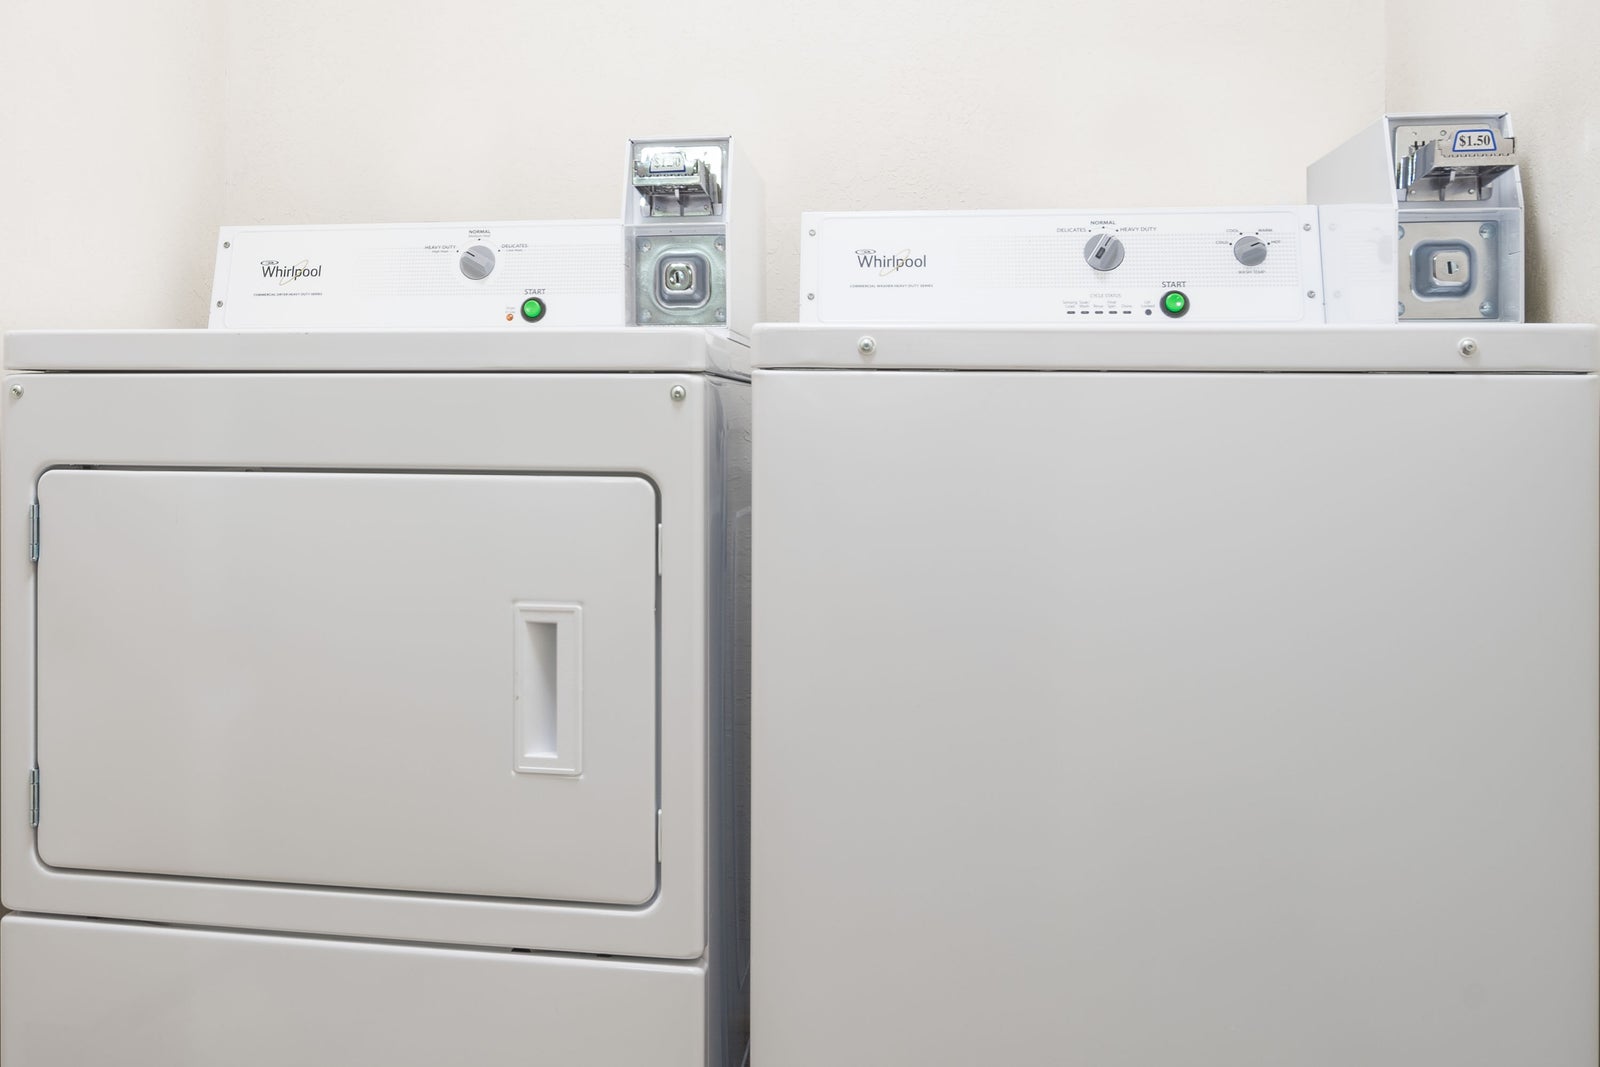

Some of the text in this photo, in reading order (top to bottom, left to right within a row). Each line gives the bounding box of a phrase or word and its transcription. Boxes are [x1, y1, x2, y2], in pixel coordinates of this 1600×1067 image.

[1459, 135, 1490, 147] $1.50
[857, 254, 927, 272] Whirlpool
[262, 265, 322, 281] Whirlpool
[1161, 280, 1187, 288] START
